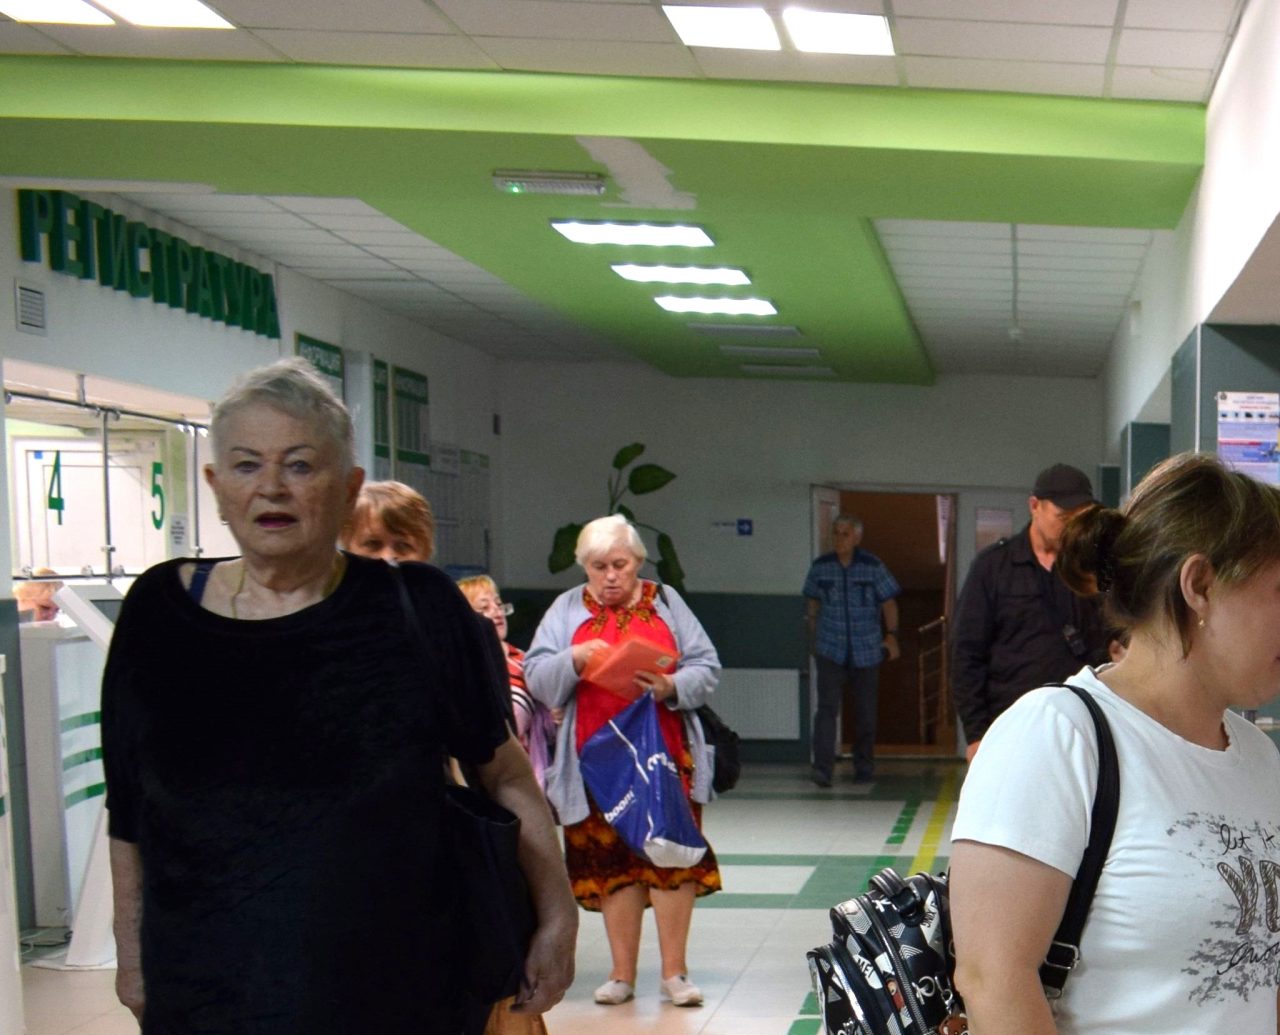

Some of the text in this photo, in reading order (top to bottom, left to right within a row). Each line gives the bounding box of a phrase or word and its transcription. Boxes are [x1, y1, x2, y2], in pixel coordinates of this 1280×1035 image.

[17, 189, 281, 339] РЕГИСТРАТУРА
[48, 450, 65, 525] 4
[152, 461, 165, 530] 5
[1220, 823, 1251, 855] let
